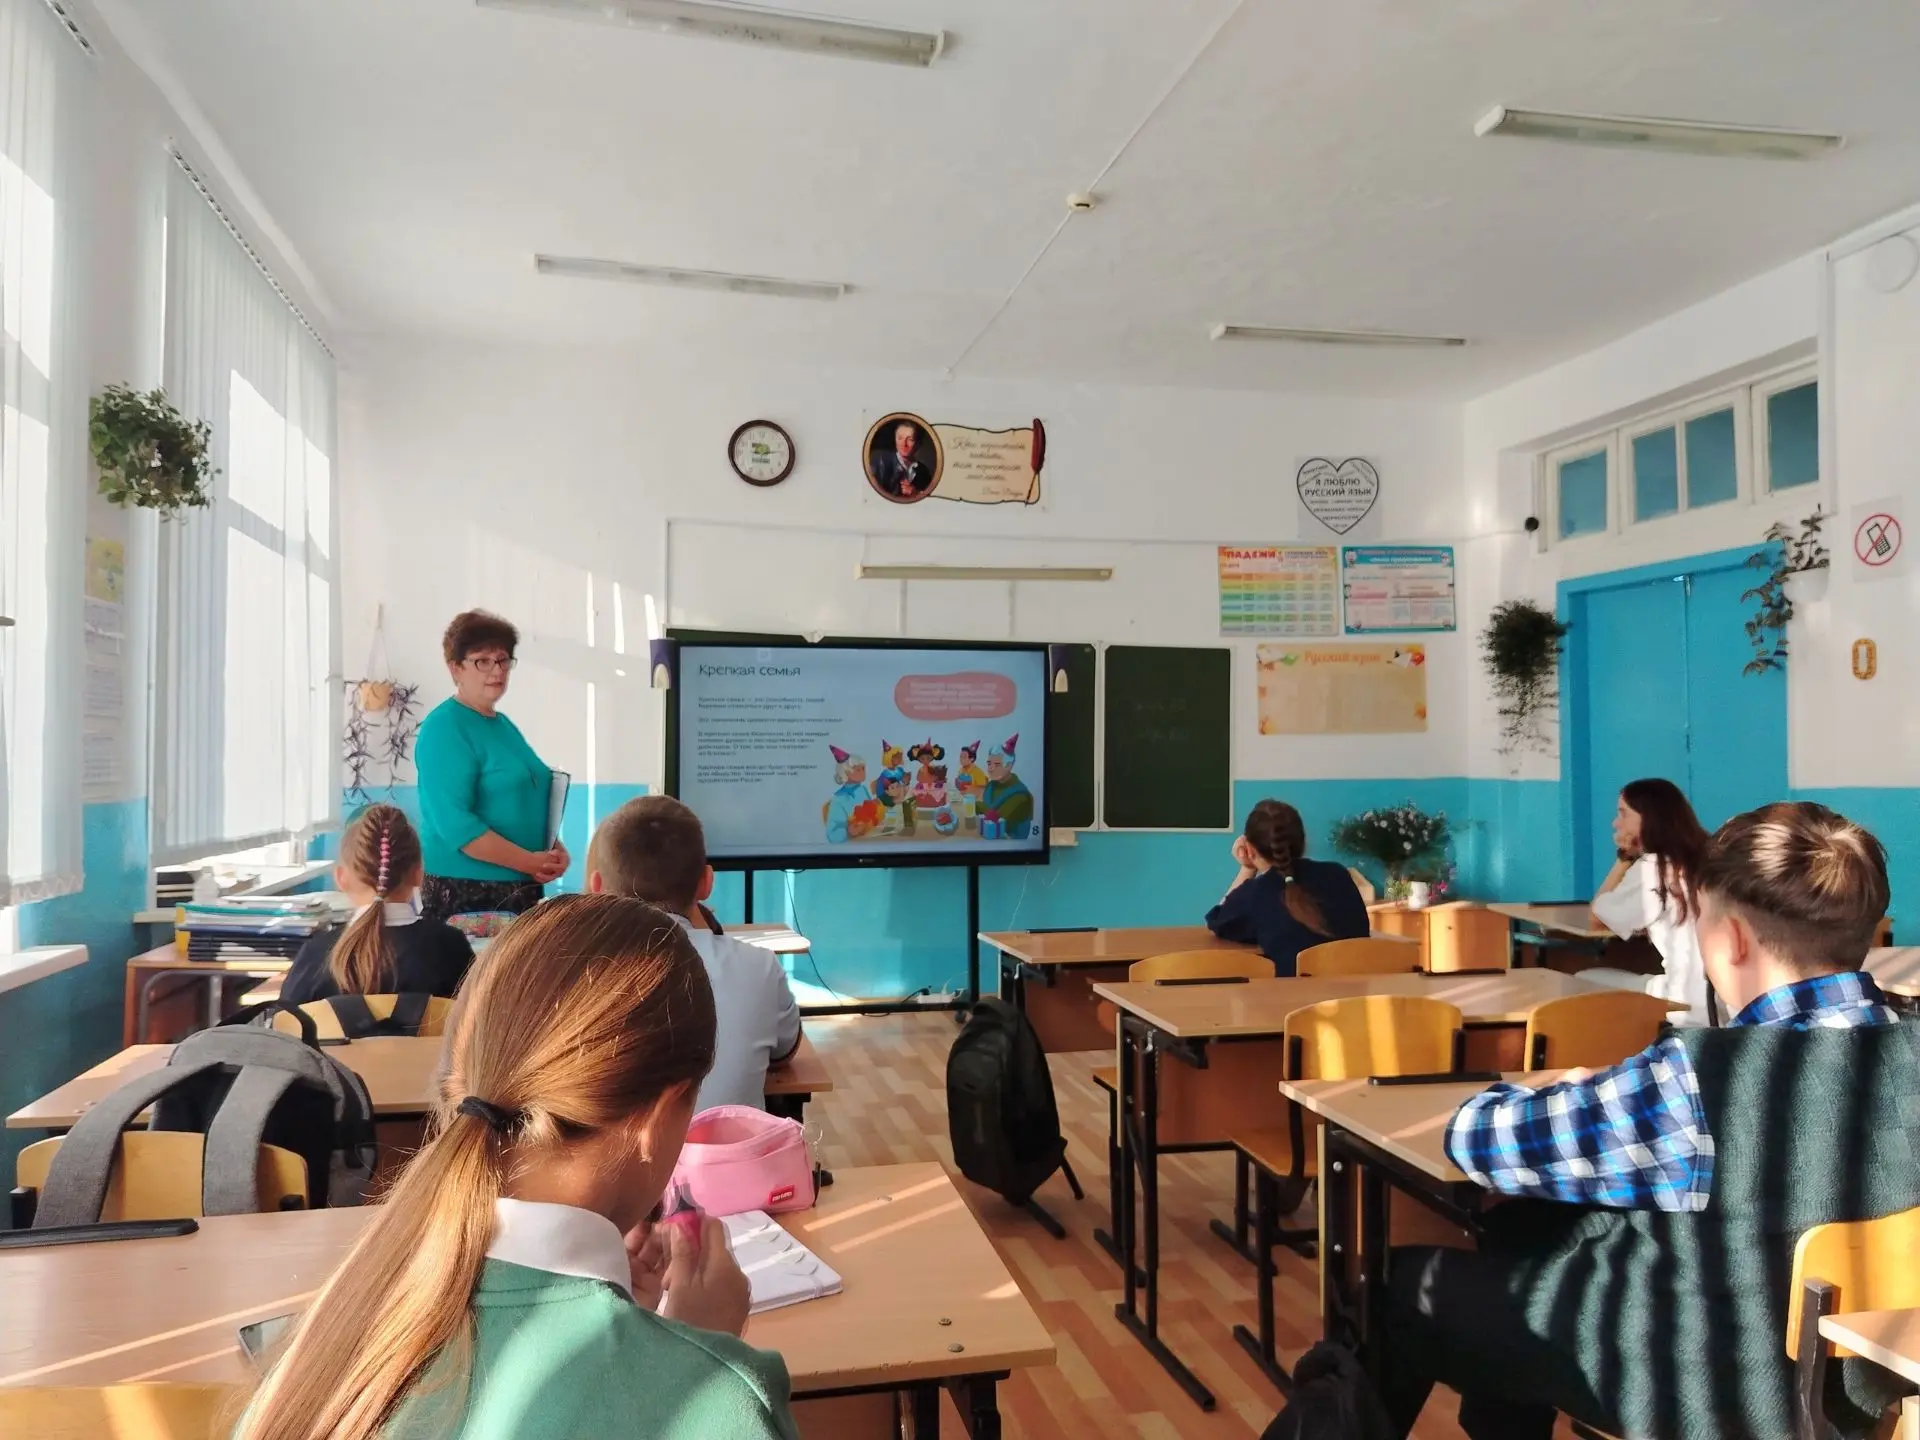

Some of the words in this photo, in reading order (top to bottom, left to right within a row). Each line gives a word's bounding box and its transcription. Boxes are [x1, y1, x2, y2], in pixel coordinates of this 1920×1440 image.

[1315, 478, 1321, 486] Я
[1323, 478, 1361, 486] ЛЮБЛЮ
[1304, 488, 1345, 497] РУССКИЙ
[1348, 488, 1372, 496] ЯЗЫК
[1226, 550, 1276, 560] ПАДЕЖИ
[699, 664, 756, 678] Крепкая
[759, 665, 801, 676] семья
